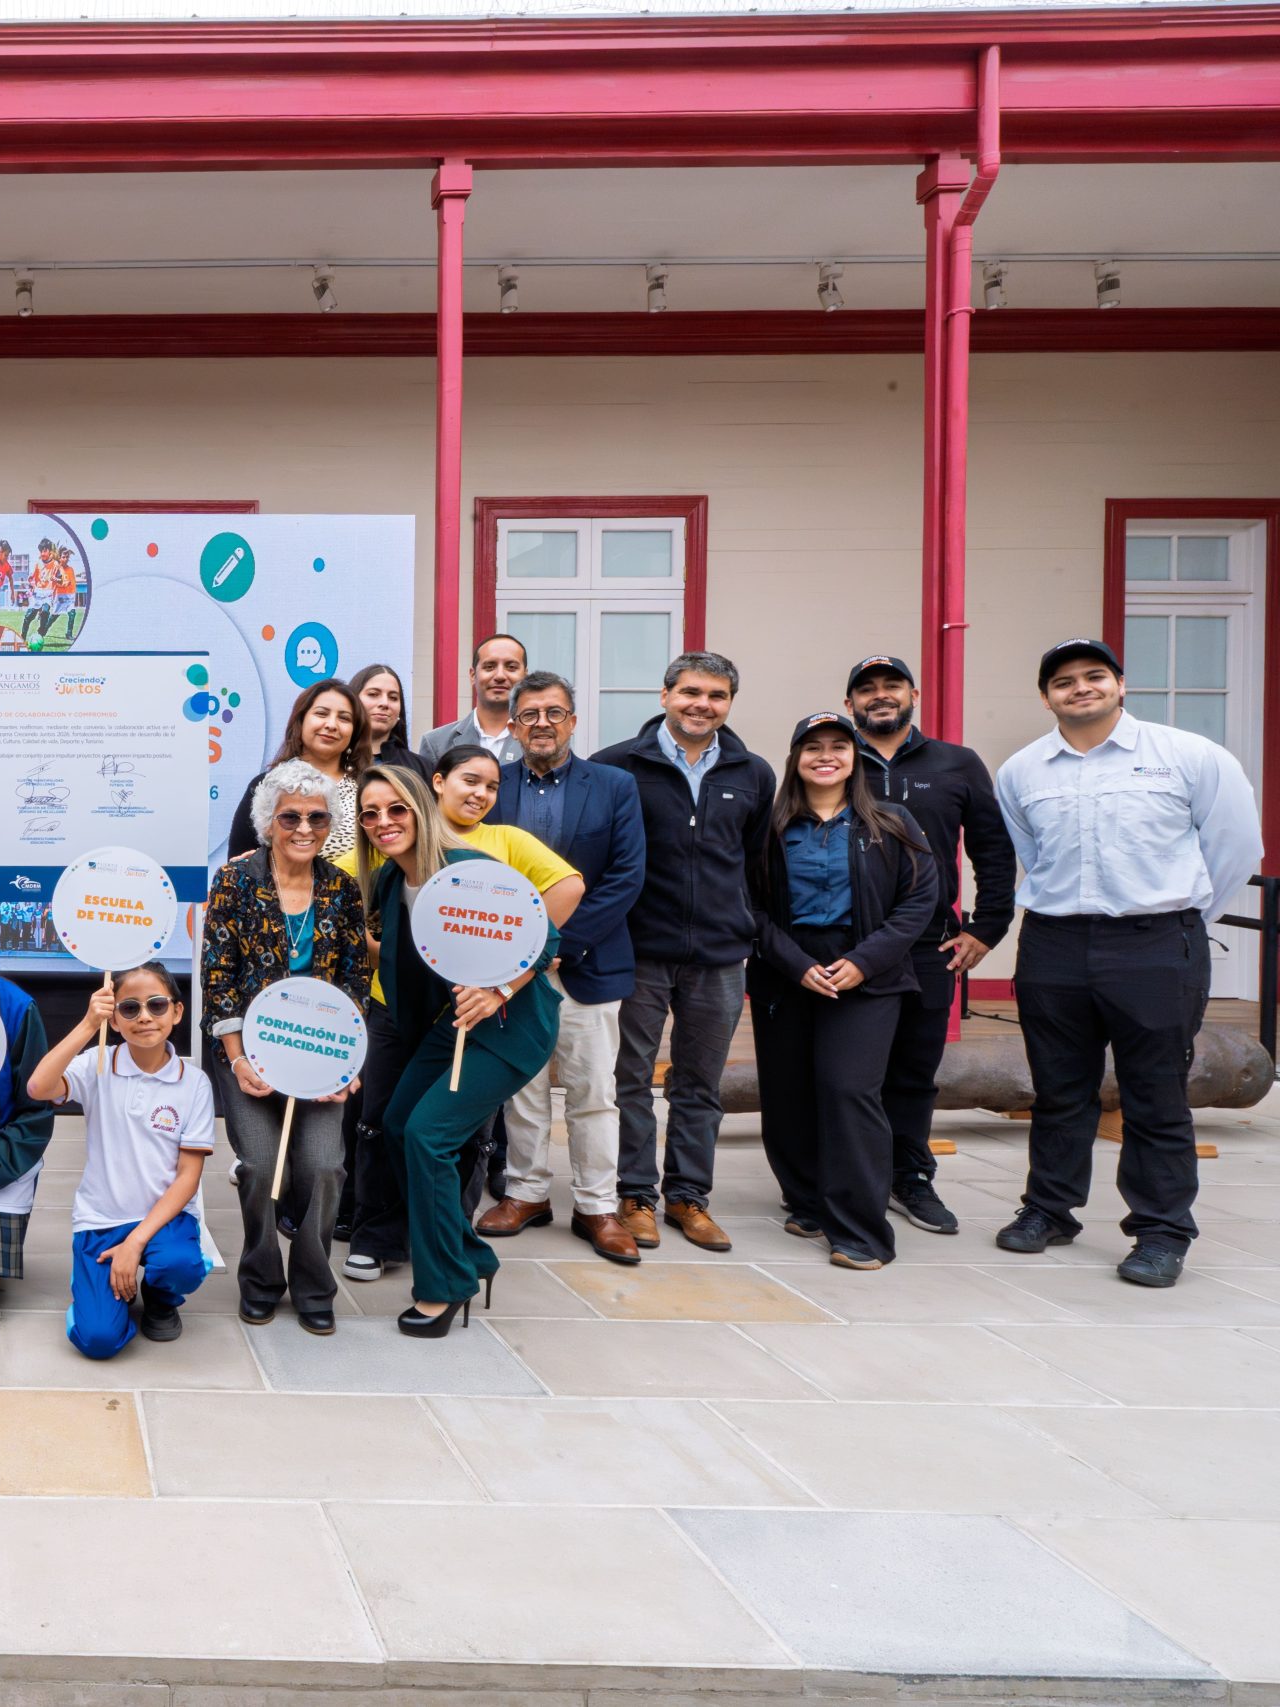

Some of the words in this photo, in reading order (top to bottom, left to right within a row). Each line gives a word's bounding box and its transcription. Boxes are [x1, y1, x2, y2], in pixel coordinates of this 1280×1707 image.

[58, 683, 101, 695] Juntos
[59, 676, 101, 684] Creciendo
[84, 894, 145, 911] ESCUELA
[76, 909, 95, 920] DE
[98, 911, 153, 927] TEATRO
[438, 905, 500, 923] CENTRO
[503, 914, 523, 927] DE
[443, 922, 513, 941] FAMILIAS
[256, 1014, 336, 1042] FORMACIÓN
[338, 1033, 357, 1047] DE
[258, 1031, 350, 1060] CAPACIDADES
